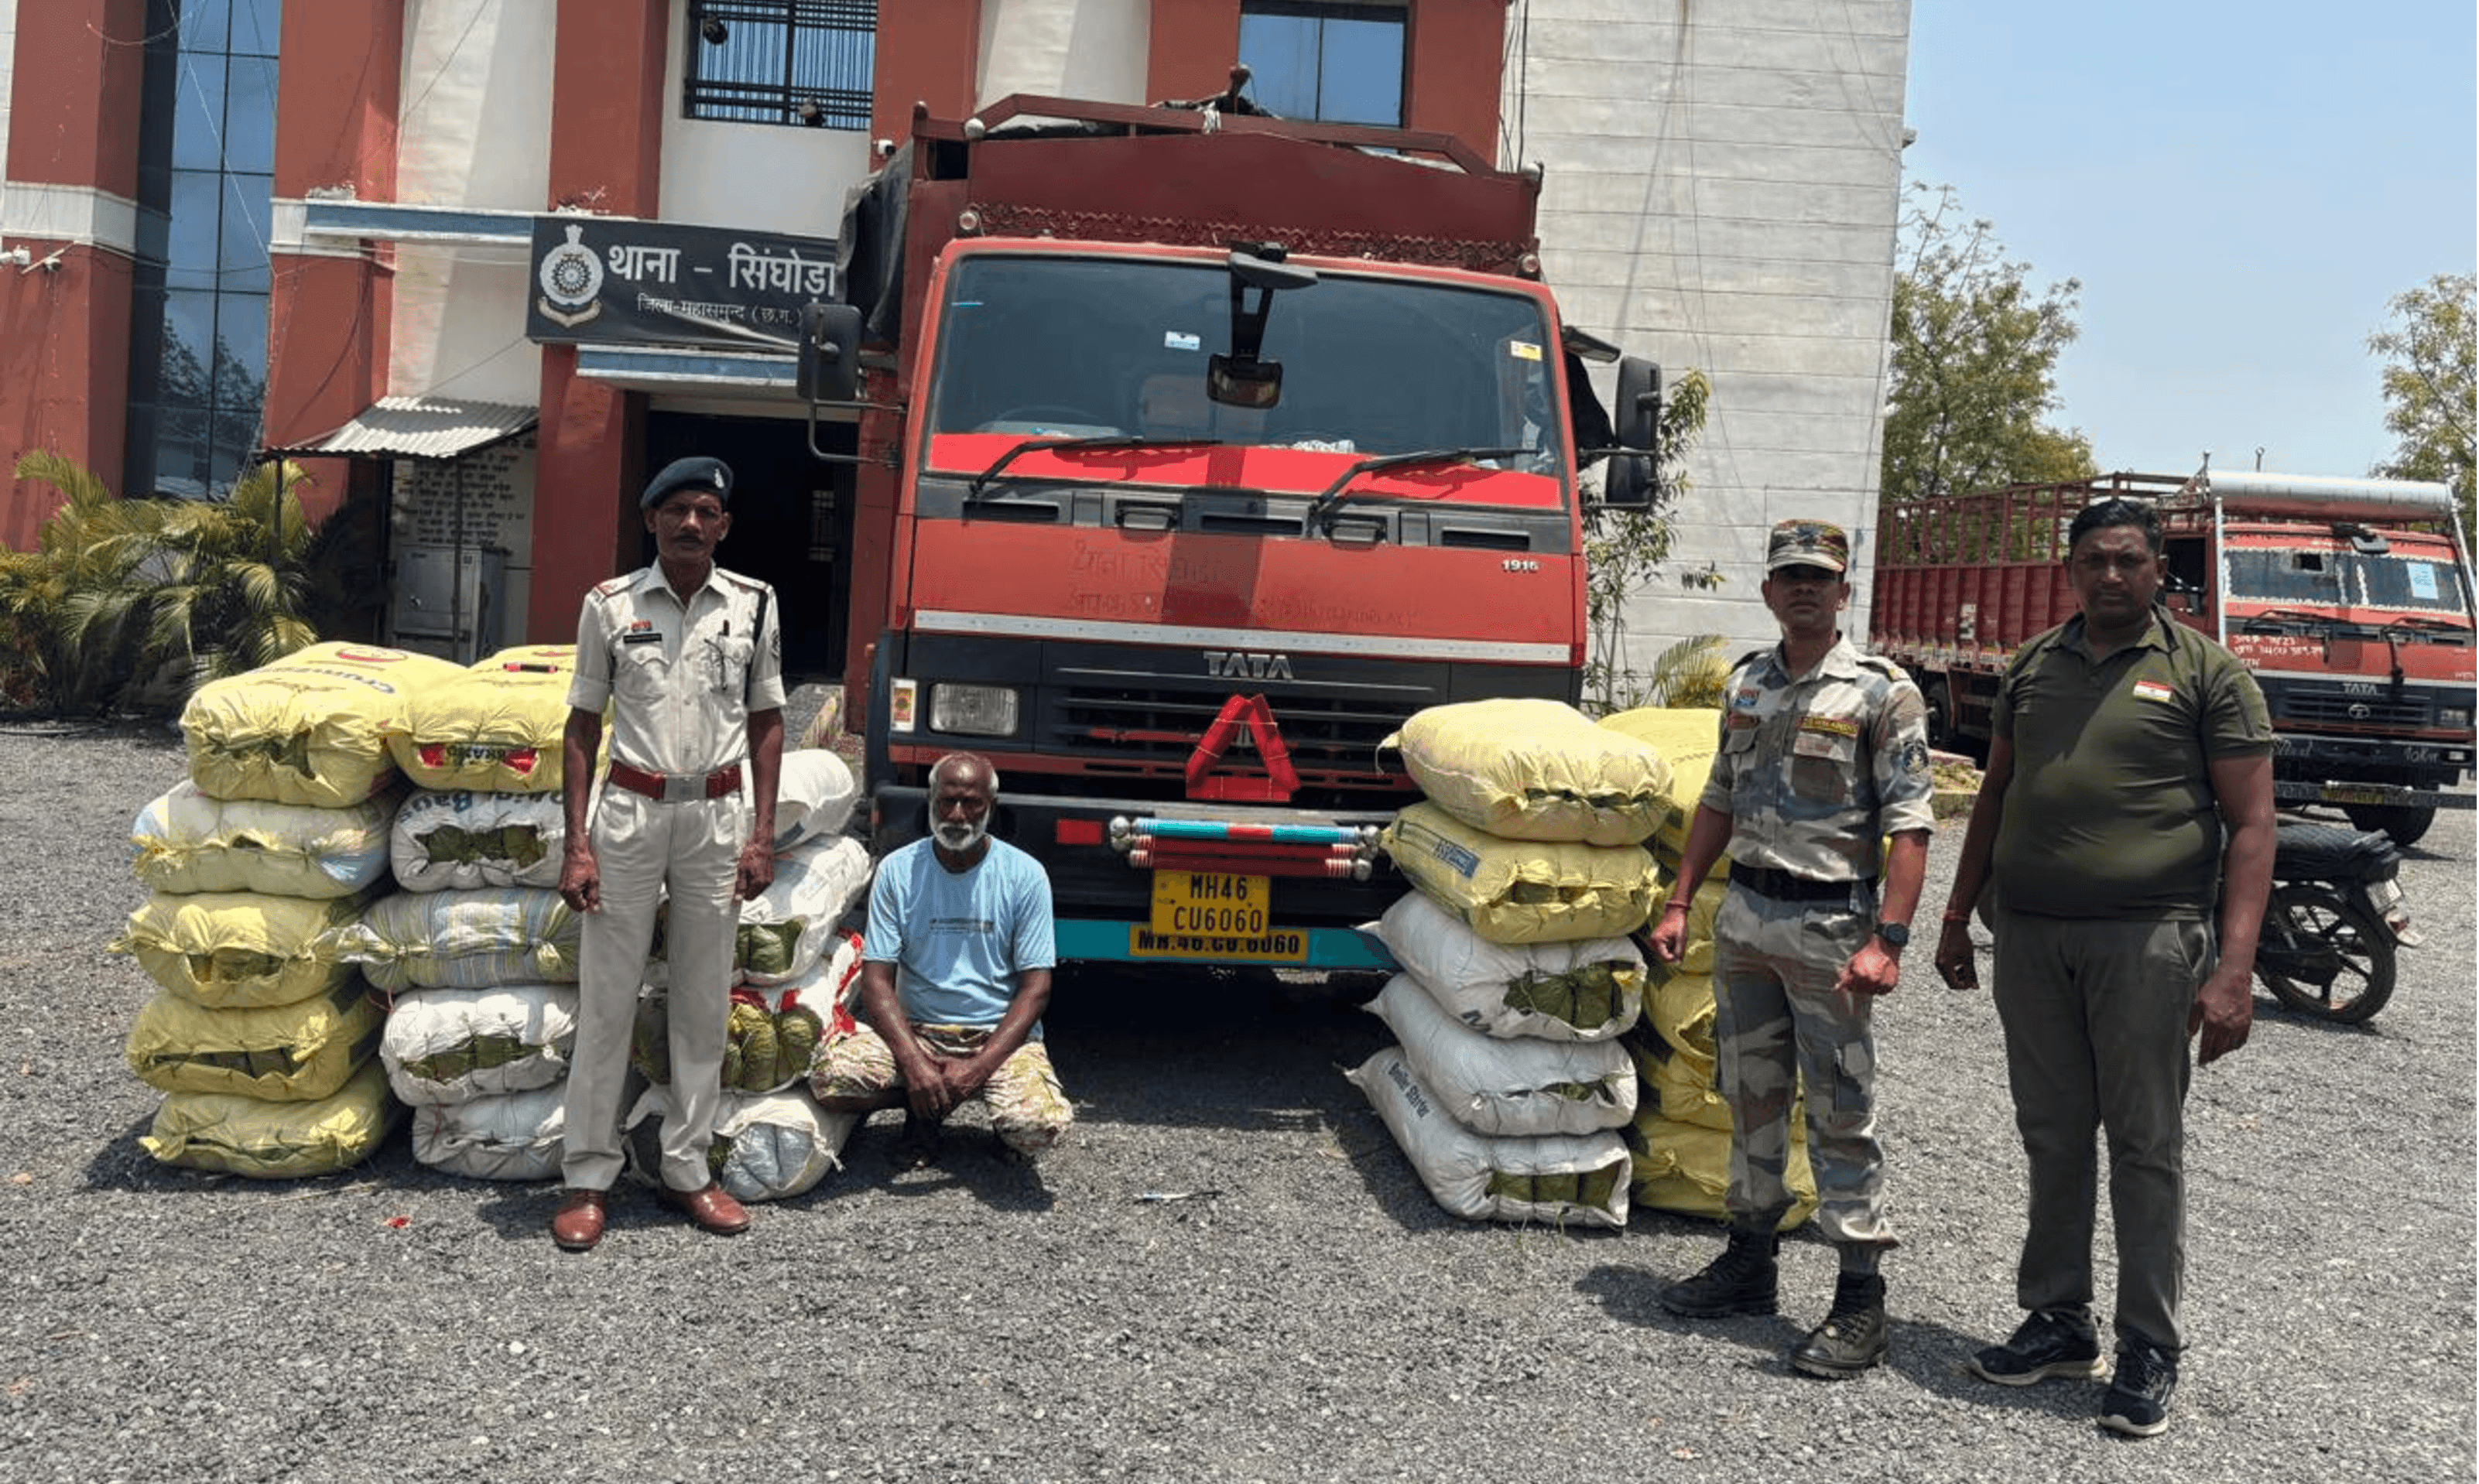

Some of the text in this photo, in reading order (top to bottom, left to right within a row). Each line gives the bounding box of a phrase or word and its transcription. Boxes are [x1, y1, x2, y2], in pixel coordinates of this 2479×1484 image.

[608, 244, 681, 283] थाना
[1502, 559, 1539, 571] 1916
[1203, 651, 1293, 679] TATA
[2343, 683, 2377, 695] TATA
[1190, 874, 1248, 901] MH46
[1174, 905, 1262, 933] CU6060
